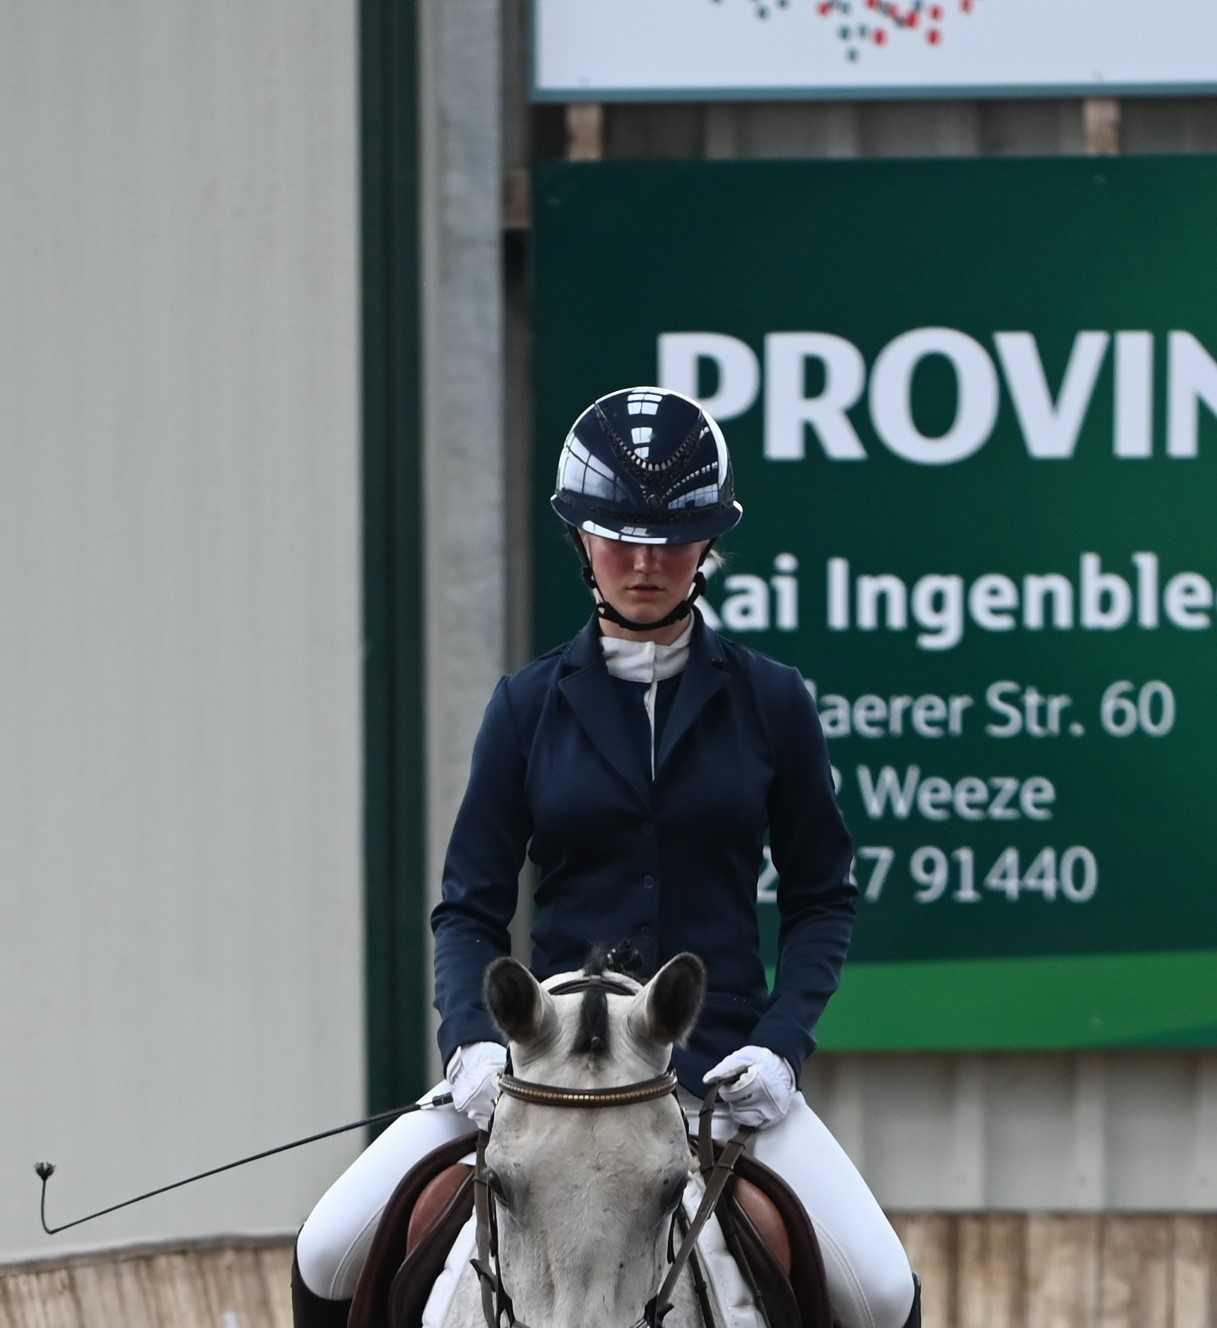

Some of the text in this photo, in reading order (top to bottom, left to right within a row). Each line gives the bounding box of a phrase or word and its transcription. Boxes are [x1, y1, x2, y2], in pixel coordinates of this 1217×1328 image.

[828, 551, 1215, 650] Ingenble
[986, 680, 1085, 737] Str.
[1101, 680, 1175, 737] 60
[857, 764, 1056, 821] Weeze
[910, 845, 1098, 903] 91440
